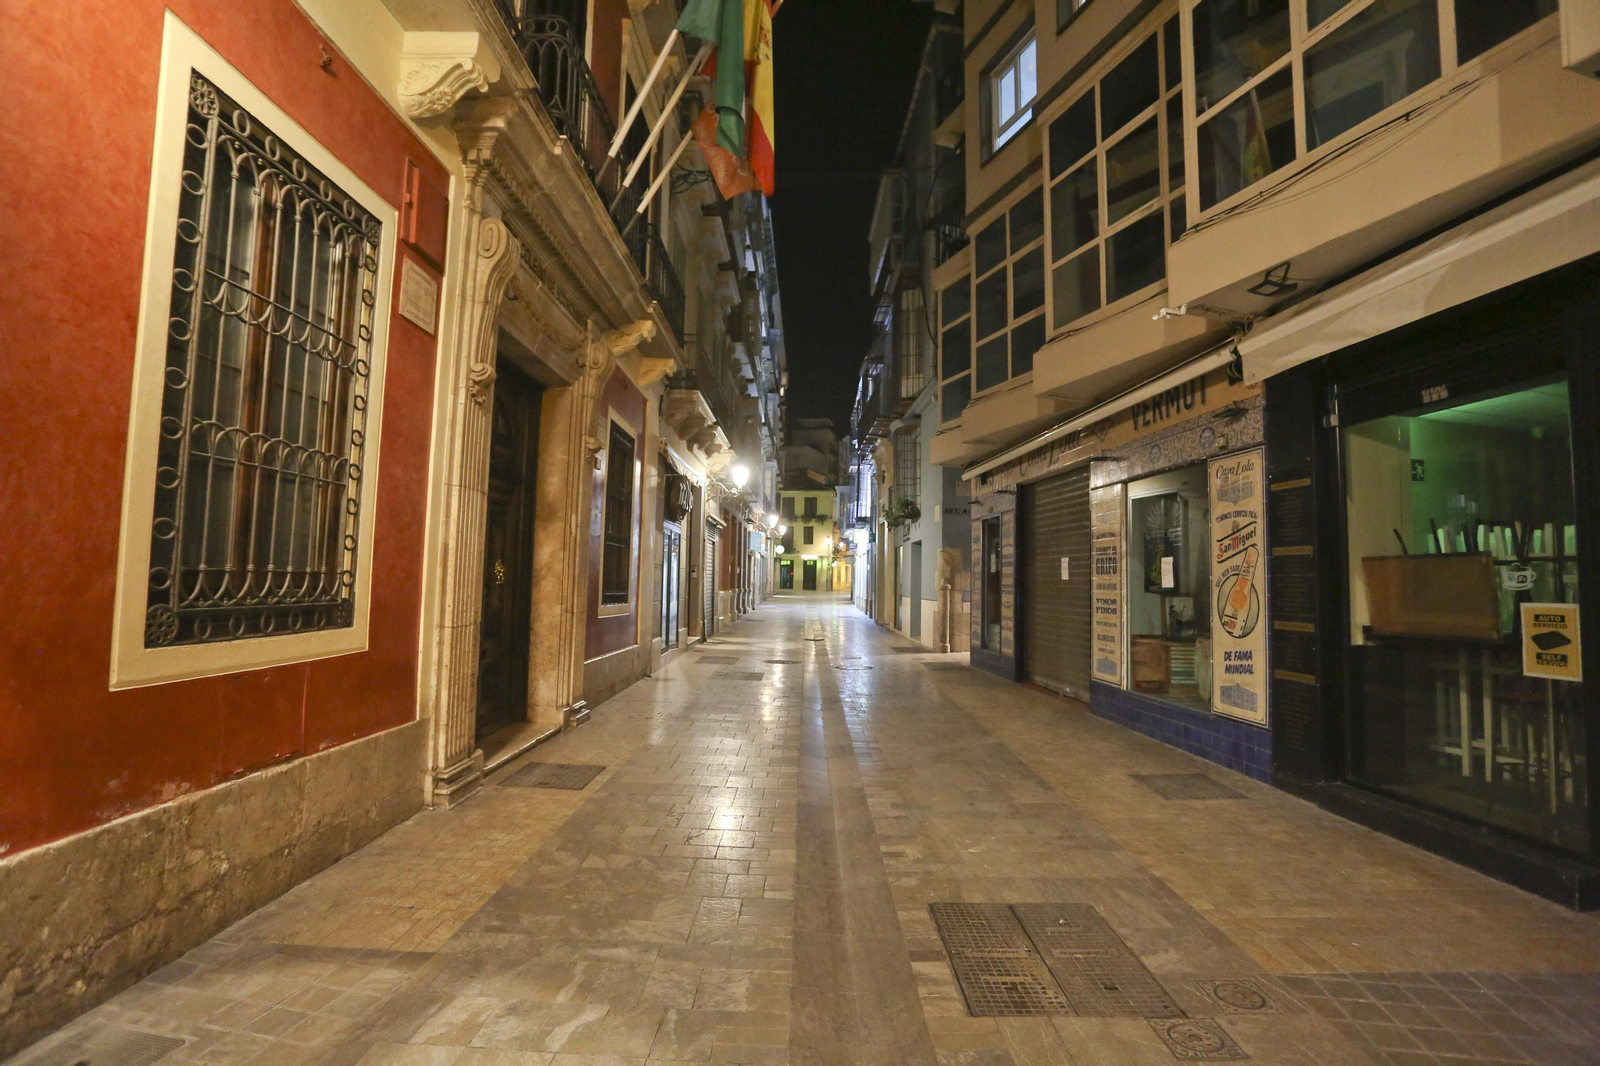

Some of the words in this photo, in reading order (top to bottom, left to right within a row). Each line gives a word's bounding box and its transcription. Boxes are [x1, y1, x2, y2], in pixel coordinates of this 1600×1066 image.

[1216, 465, 1234, 479] Casa
[1235, 459, 1254, 475] Lola
[1217, 543, 1231, 559] San
[1229, 526, 1256, 551] Miguel
[1096, 556, 1117, 575] GRIFO
[1096, 598, 1117, 606] VINOS
[1096, 607, 1117, 615] FINOS
[1533, 622, 1568, 630] SERVICIO
[1224, 651, 1232, 662] DE
[1233, 650, 1253, 662] FAMA
[1541, 653, 1562, 661] SELF
[1225, 663, 1254, 675] MUNDIAL
[1536, 660, 1568, 668] SERVICE
